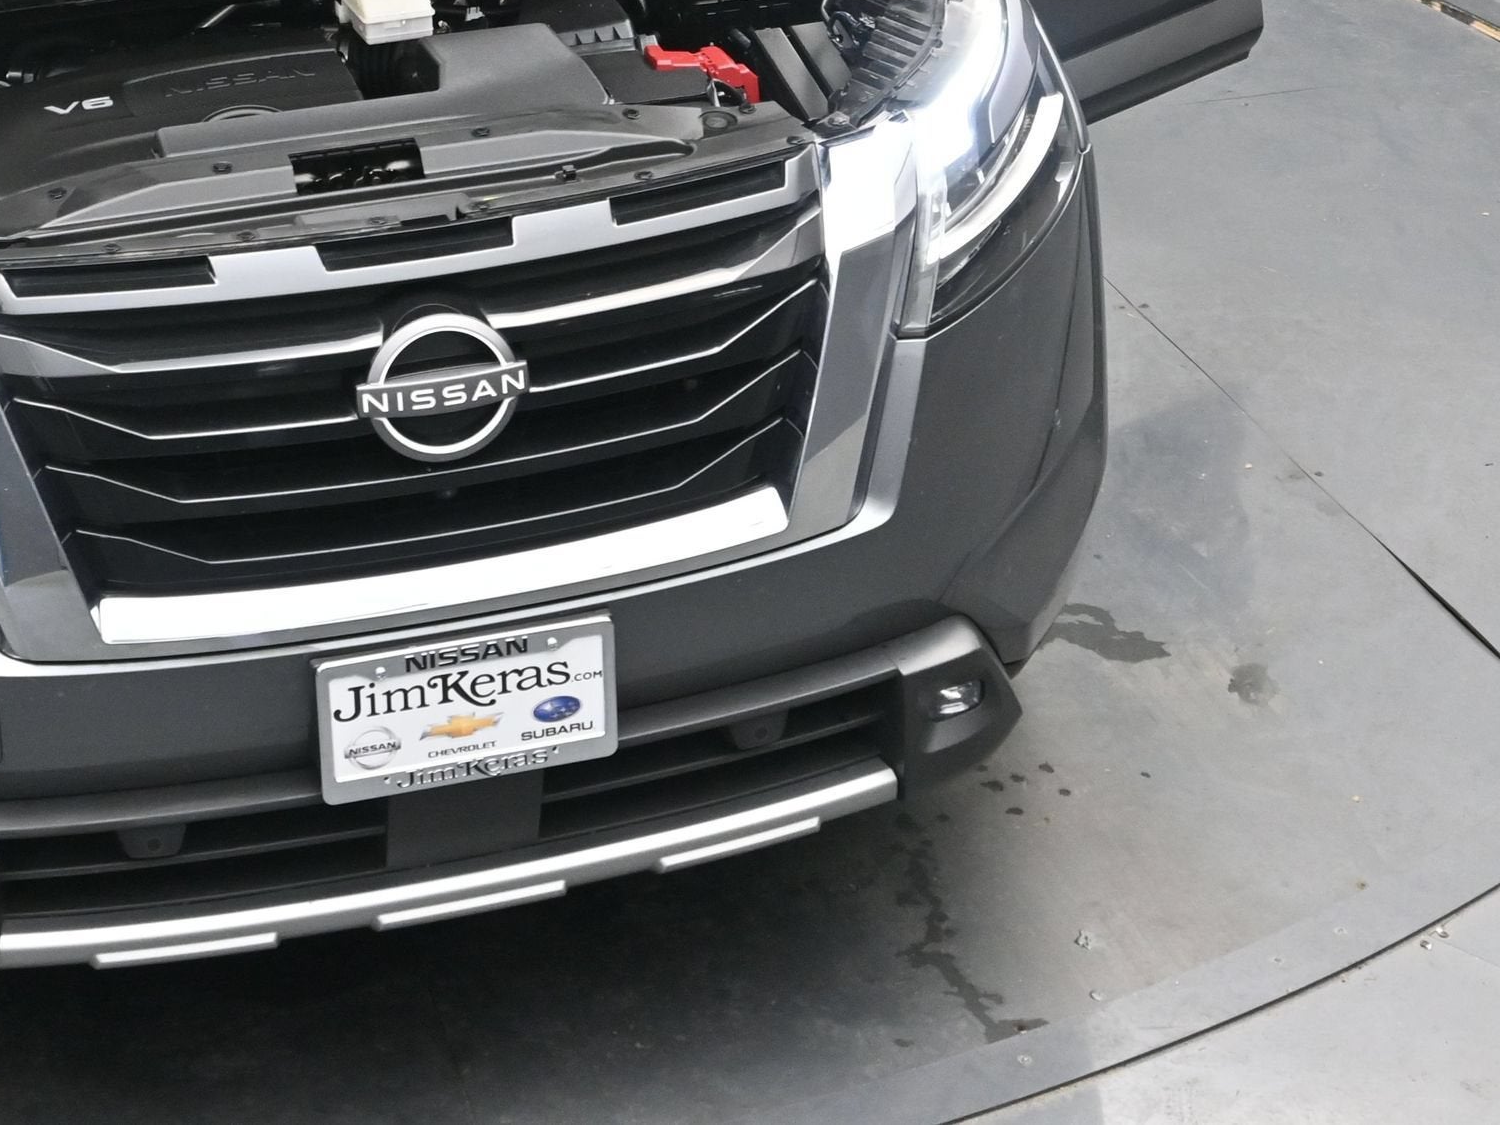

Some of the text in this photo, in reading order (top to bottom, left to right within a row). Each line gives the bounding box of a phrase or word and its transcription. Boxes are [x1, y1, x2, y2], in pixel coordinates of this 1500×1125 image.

[43, 95, 114, 115] V6
[362, 369, 526, 414] NISSAN
[405, 636, 528, 673] NISSAN
[521, 721, 594, 742] SUBARU
[348, 740, 397, 756] NISSAN
[428, 740, 497, 758] CHEVROLET
